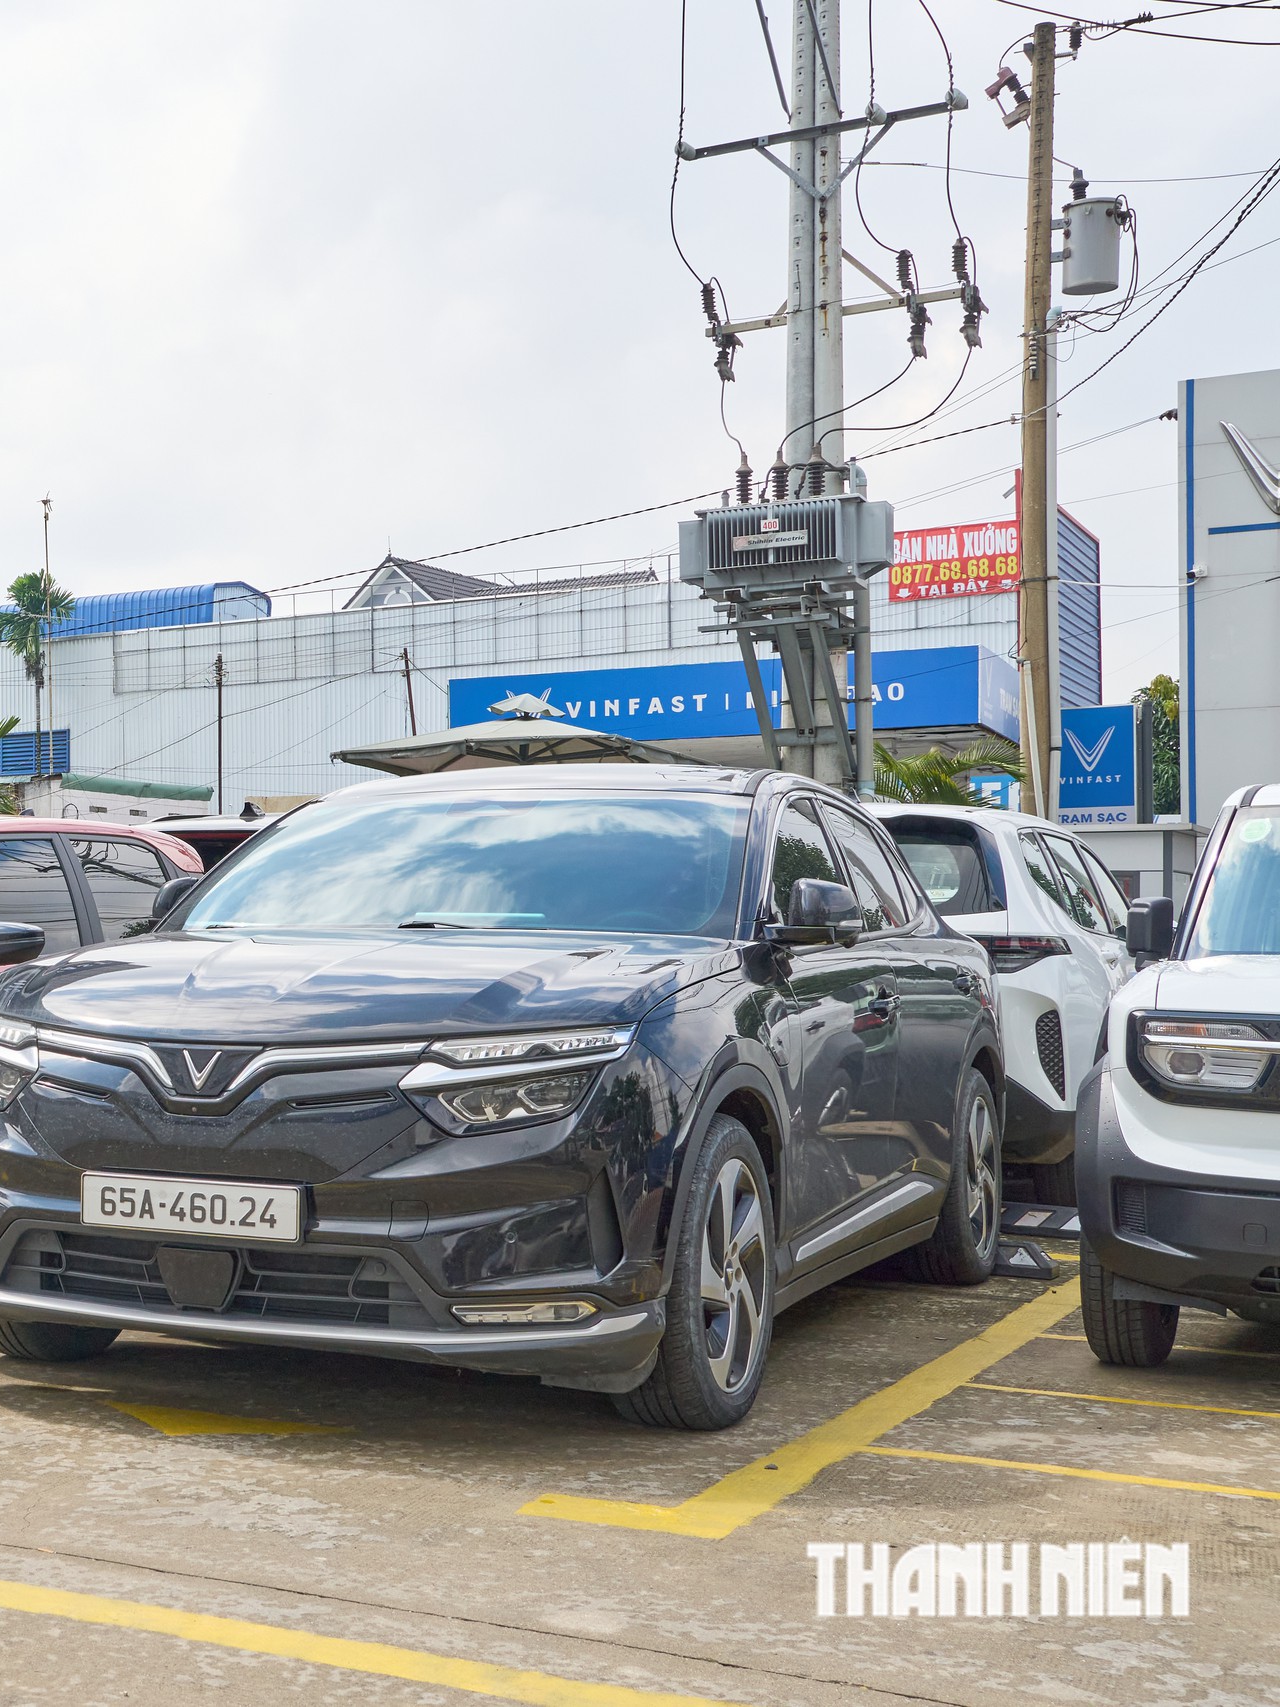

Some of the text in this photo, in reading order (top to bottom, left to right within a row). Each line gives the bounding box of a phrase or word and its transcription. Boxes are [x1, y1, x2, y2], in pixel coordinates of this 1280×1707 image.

[763, 520, 777, 530] 400
[775, 535, 805, 543] Electric
[893, 523, 1017, 564] BÁN NHÀ XƯỞNG
[891, 556, 1018, 585] 0877.68.68.68
[918, 578, 989, 598] TẠI ĐÂY
[565, 693, 708, 719] VINFAST
[1059, 774, 1121, 785] VINFAST
[1058, 812, 1127, 825] RẠM SẠC
[100, 1186, 277, 1229] 65A-460.24
